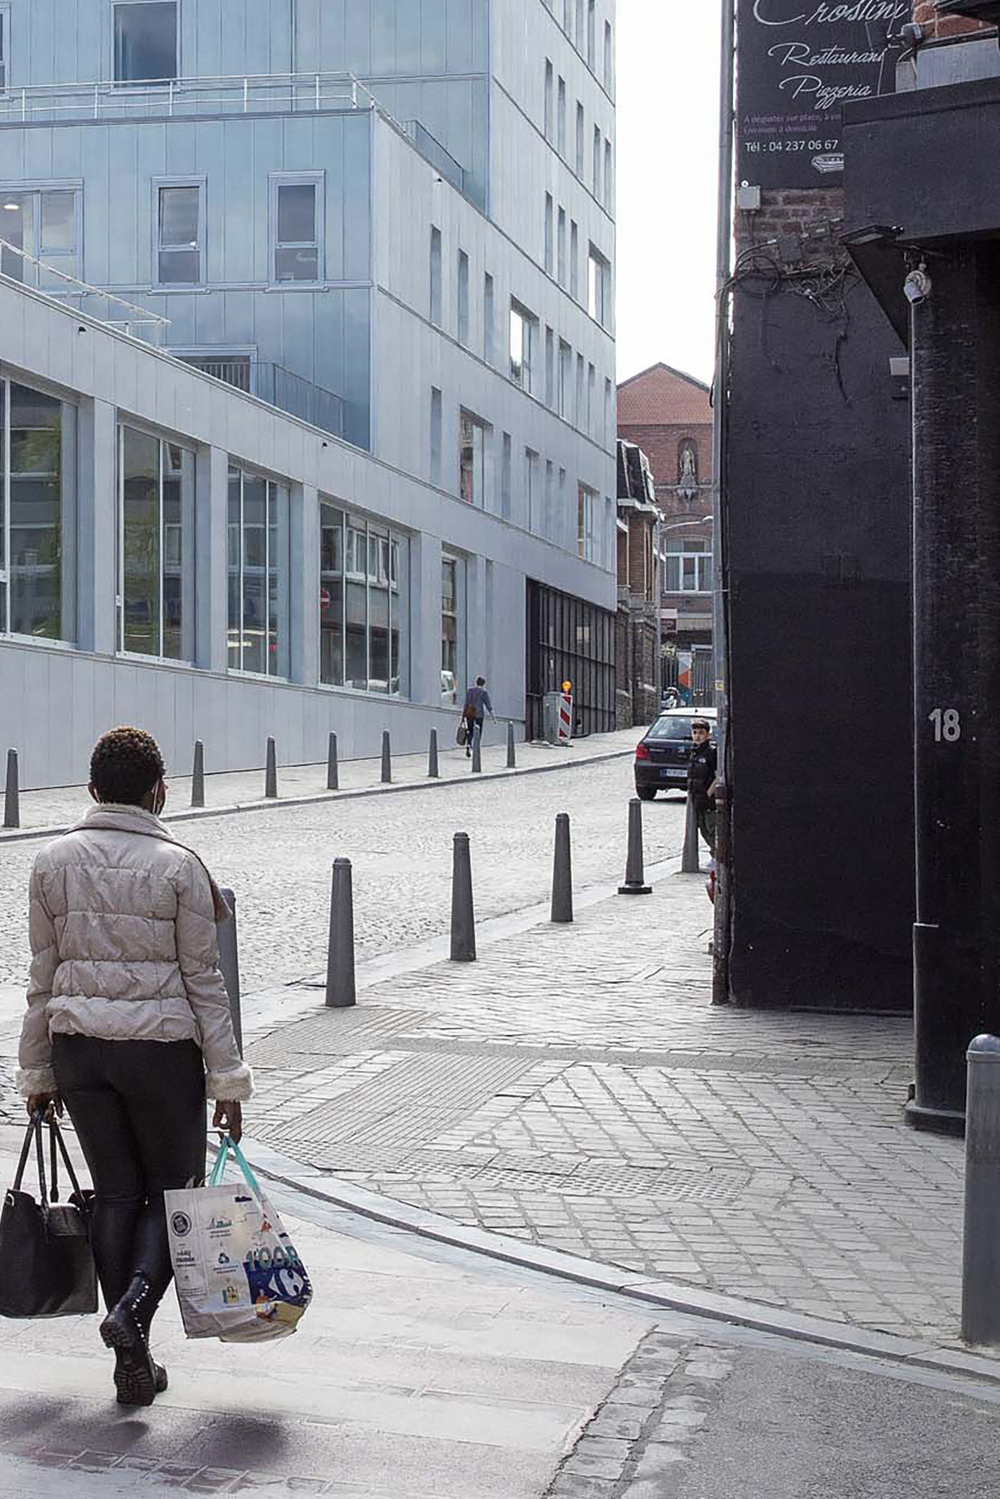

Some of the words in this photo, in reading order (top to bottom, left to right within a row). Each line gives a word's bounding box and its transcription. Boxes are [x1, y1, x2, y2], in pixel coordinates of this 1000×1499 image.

[767, 42, 886, 67] Restaurant
[778, 75, 872, 110] Pizzeria
[768, 140, 783, 152] 04
[785, 139, 806, 151] 237
[807, 139, 822, 151] 06
[825, 138, 839, 150] 67
[928, 708, 961, 742] 18
